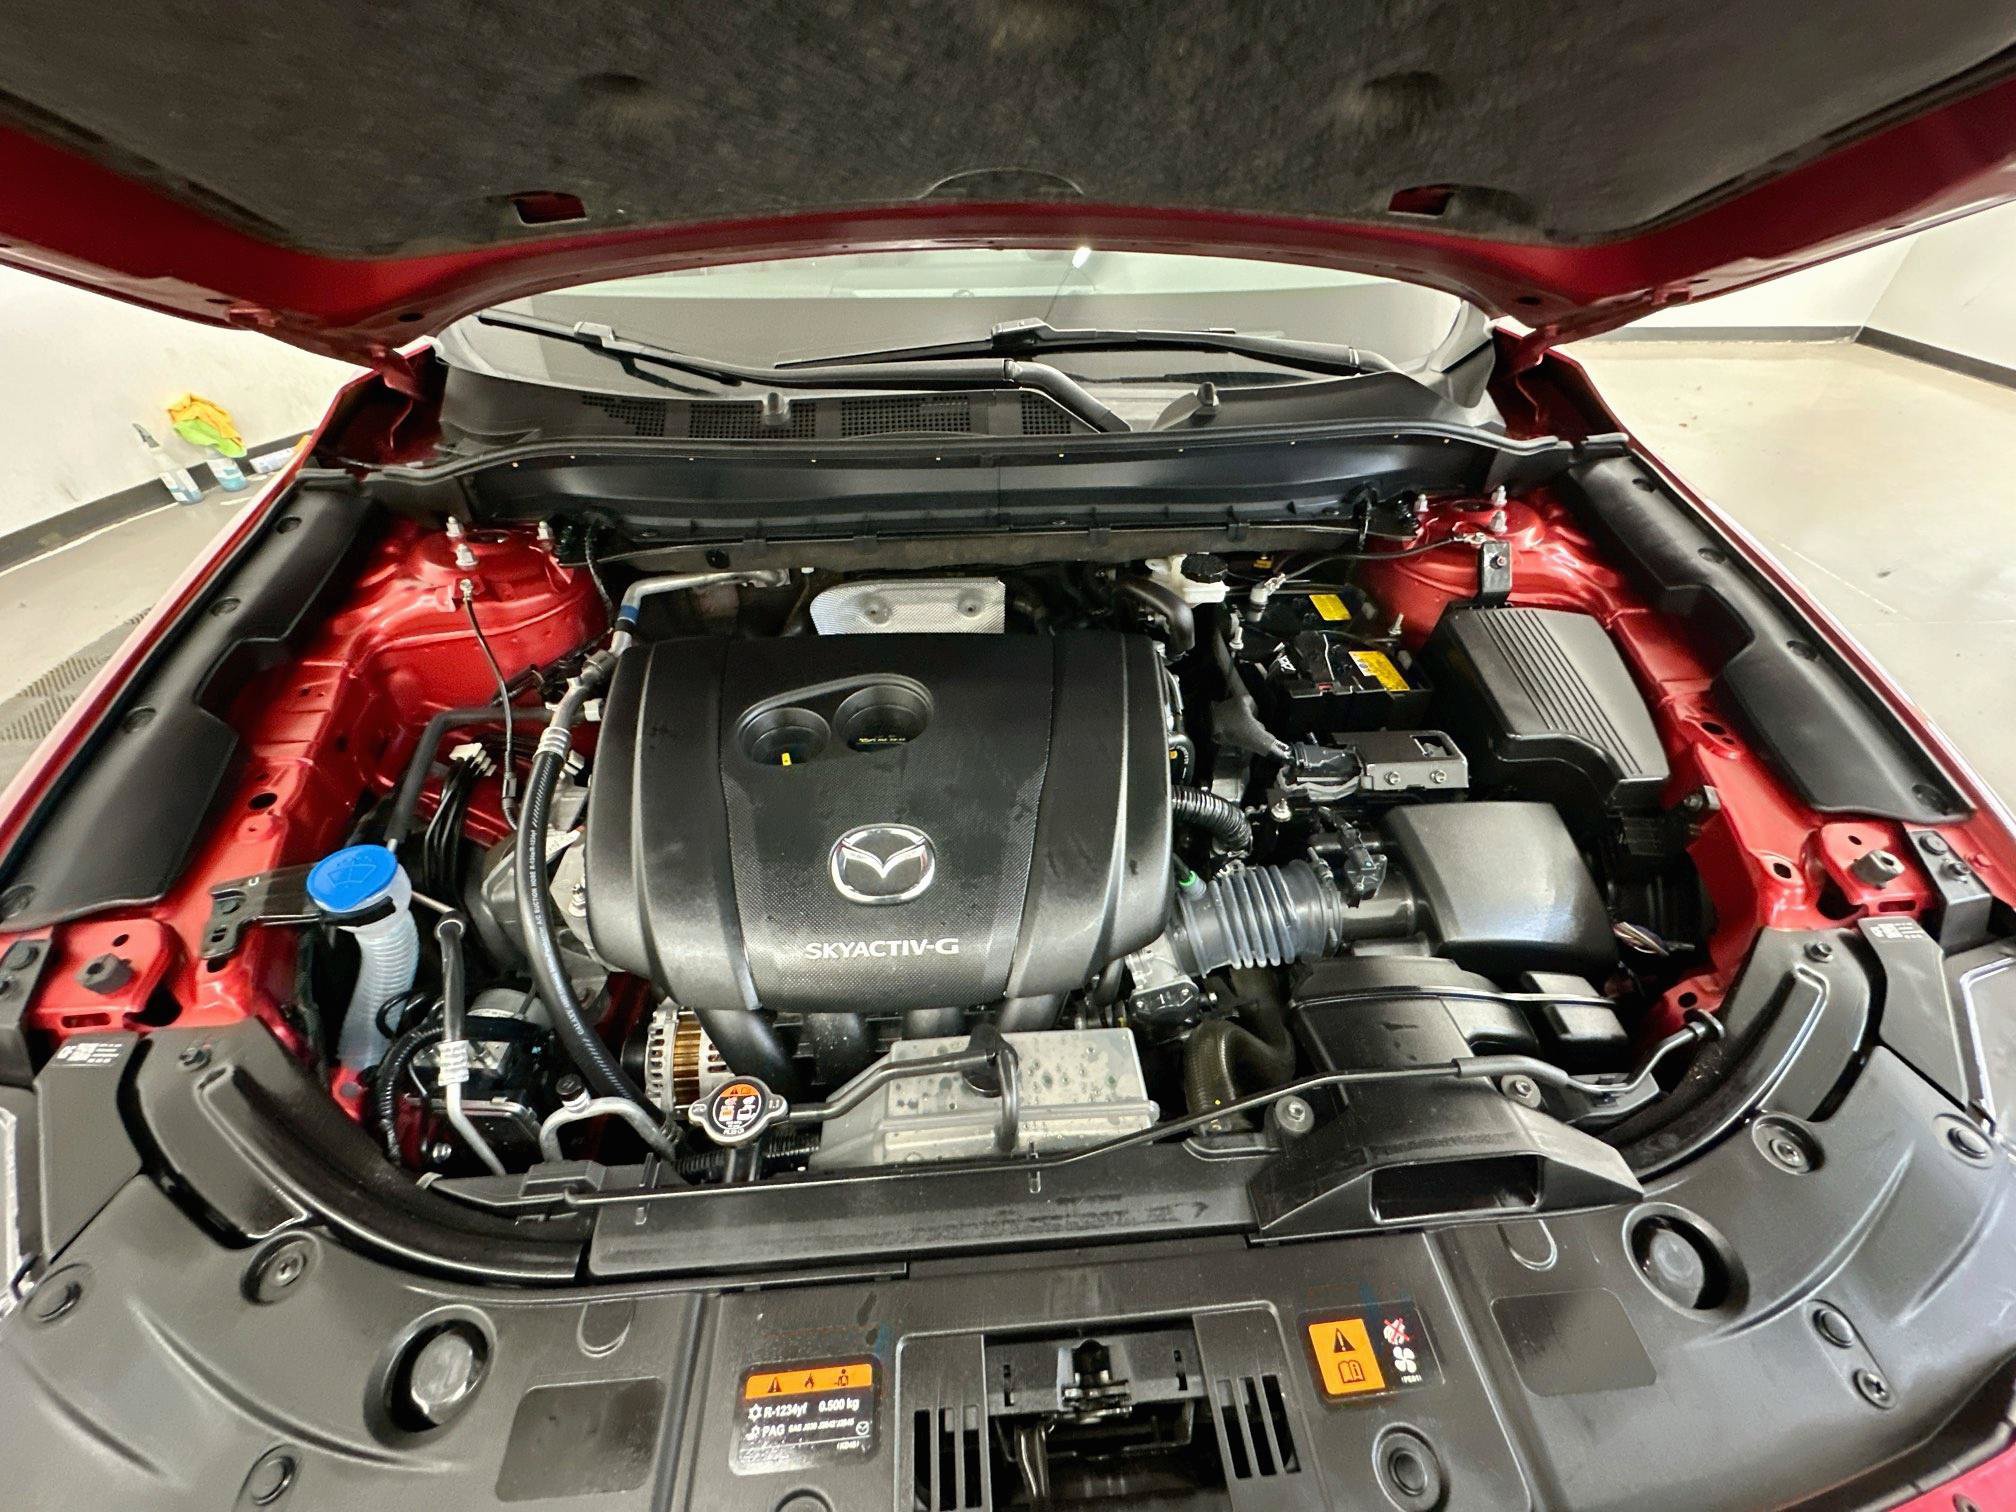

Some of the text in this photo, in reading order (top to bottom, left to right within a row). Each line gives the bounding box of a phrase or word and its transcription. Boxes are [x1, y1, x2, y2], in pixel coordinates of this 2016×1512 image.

[805, 938, 960, 959] SKYACTIV-G
[763, 1397, 860, 1418] R-1234yf 0.500 kg
[762, 1423, 786, 1438] PAG
